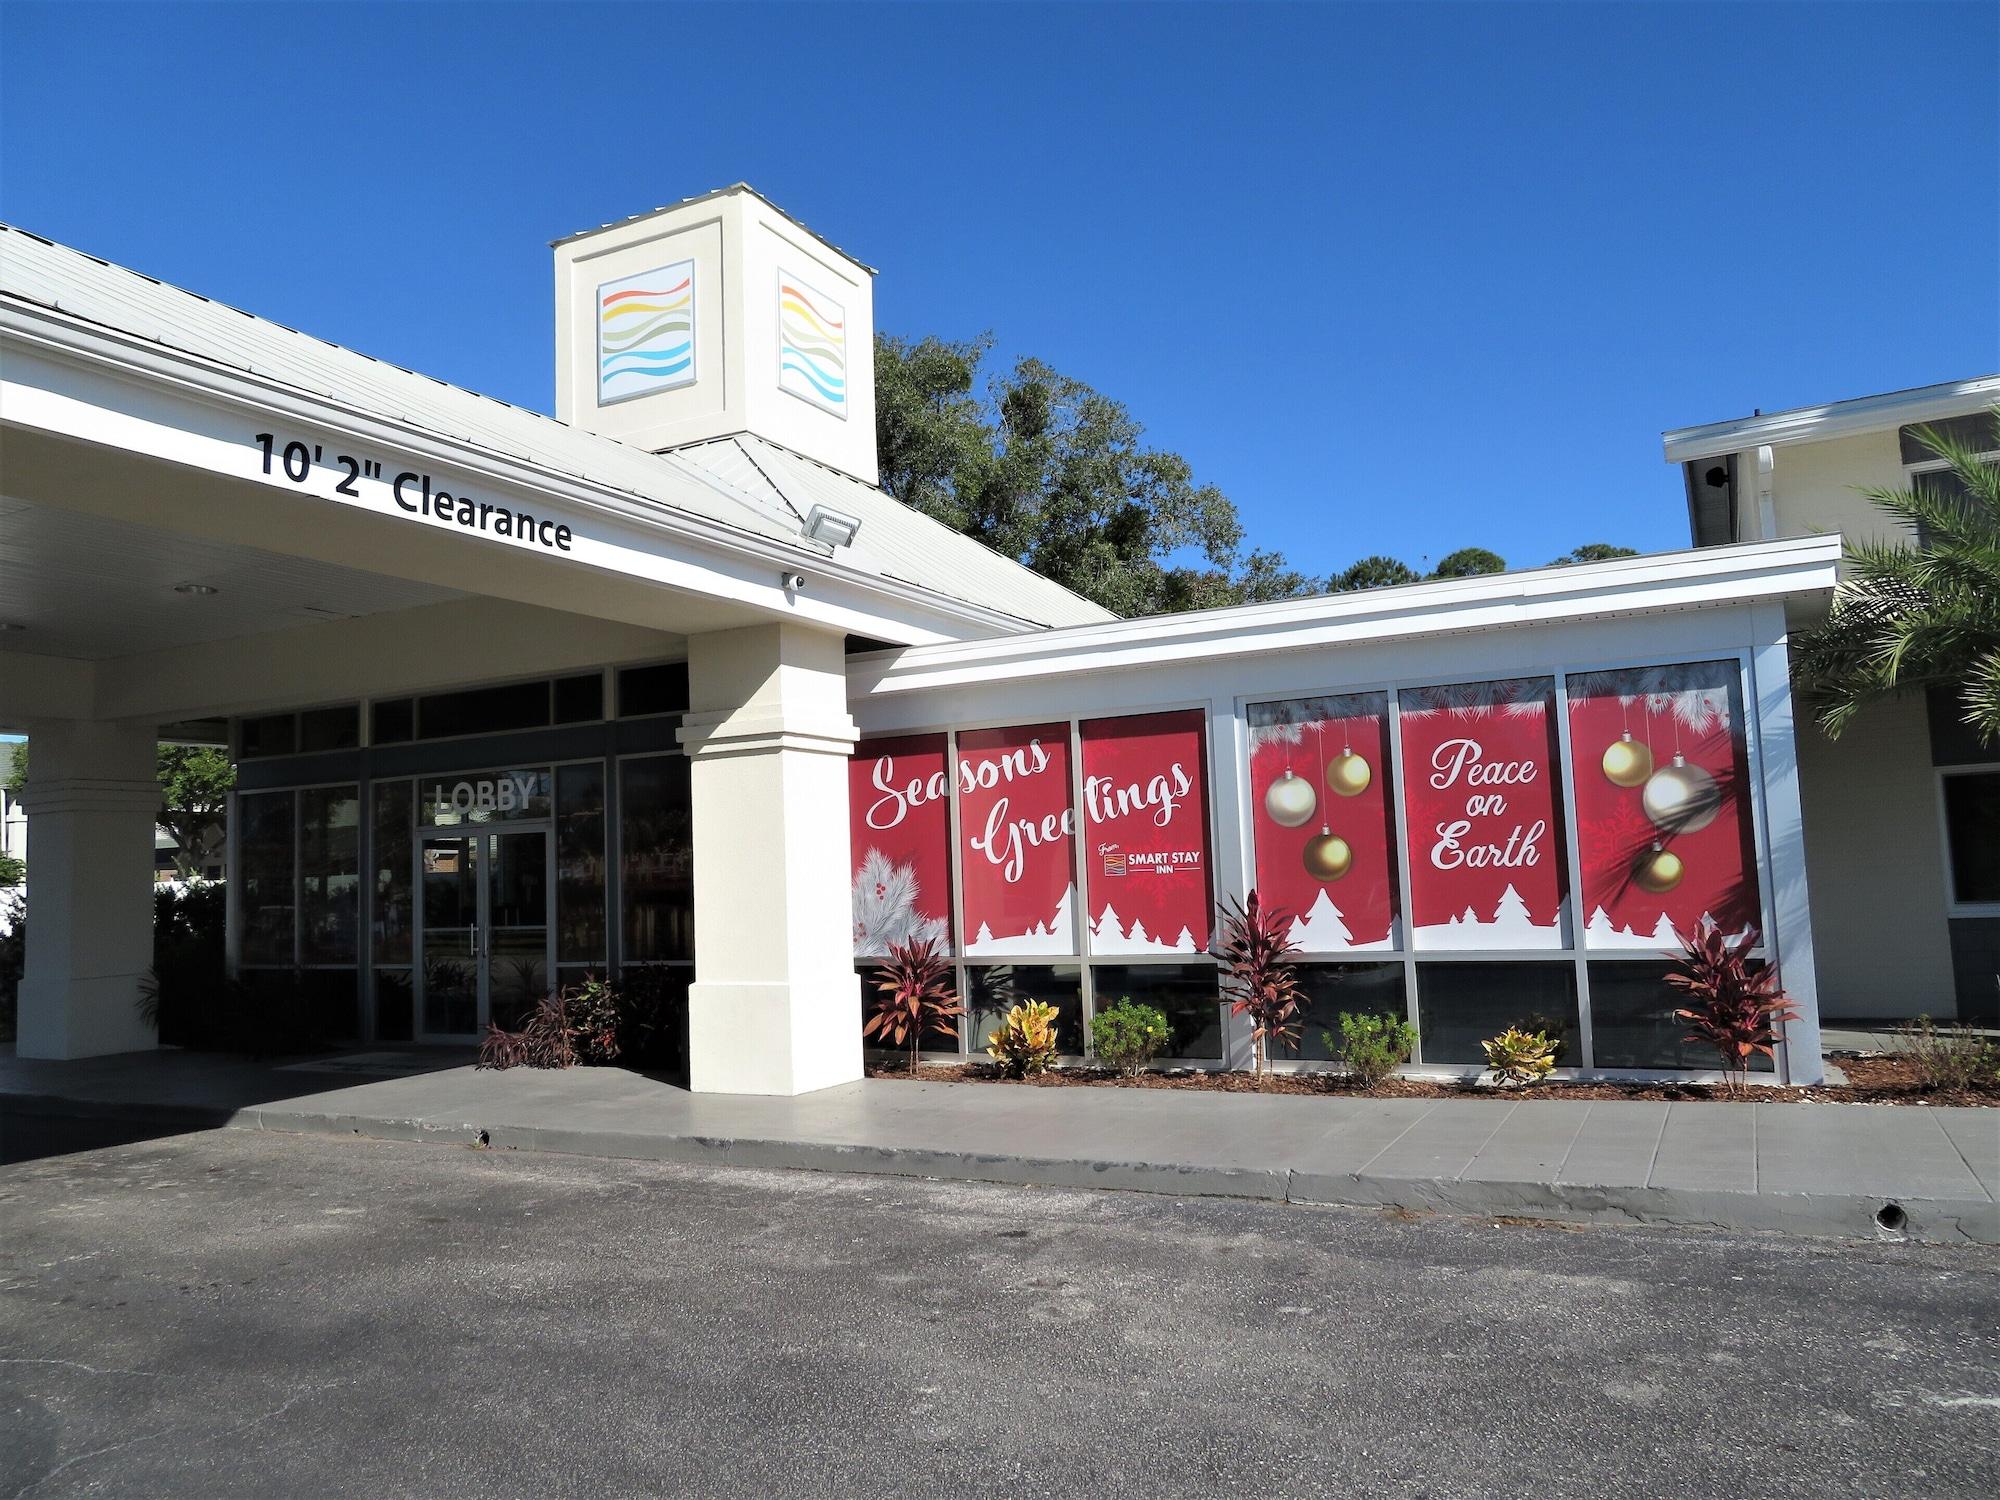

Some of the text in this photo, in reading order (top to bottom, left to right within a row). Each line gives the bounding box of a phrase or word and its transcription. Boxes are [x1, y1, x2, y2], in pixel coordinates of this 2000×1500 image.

[255, 433, 572, 551] 10' 2" Clearance
[866, 738, 1051, 830] Seasons
[1430, 738, 1538, 790] Peace
[434, 776, 537, 816] LOBBY
[1465, 793, 1508, 817] on
[970, 762, 1194, 883] Greetings
[1431, 819, 1546, 870] Earth
[1128, 851, 1200, 865] SMART STAY
[1156, 865, 1173, 874] INN
